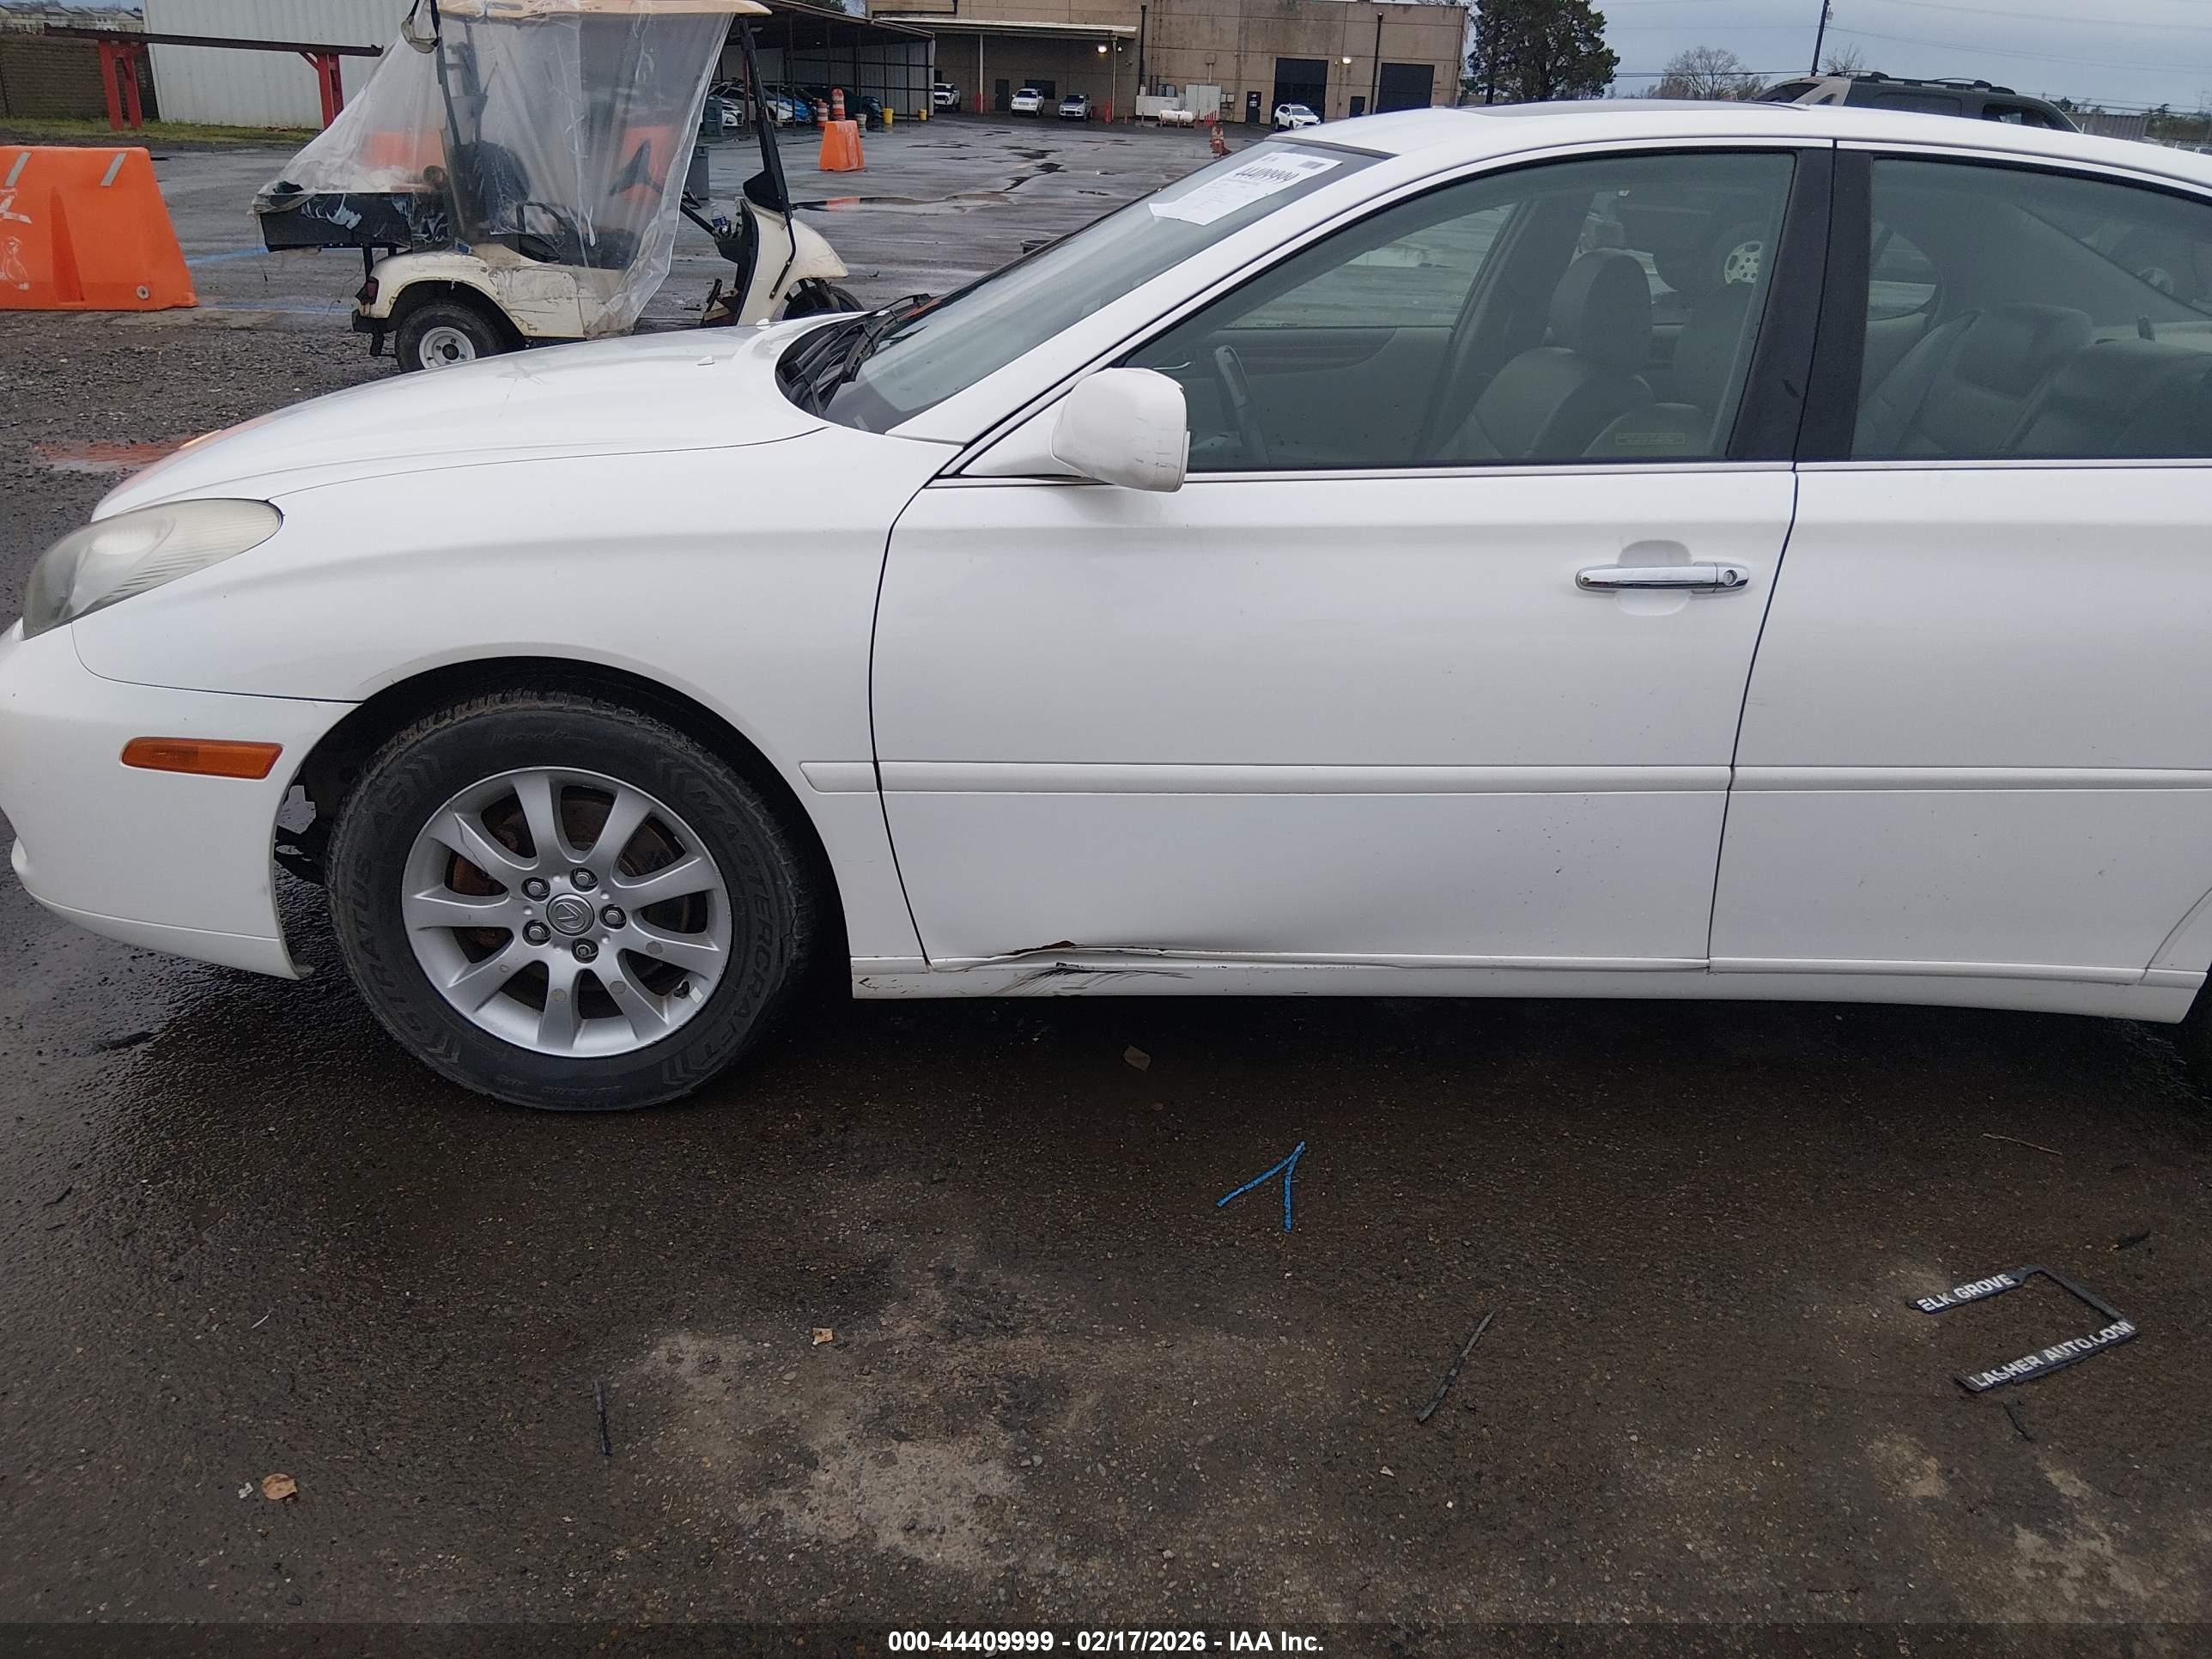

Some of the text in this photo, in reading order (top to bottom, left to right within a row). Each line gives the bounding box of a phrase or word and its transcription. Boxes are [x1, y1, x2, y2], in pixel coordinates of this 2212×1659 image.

[1917, 1273, 2015, 1312] ELK GROVE
[1968, 1319, 2136, 1388] LASHER AUTO.COM
